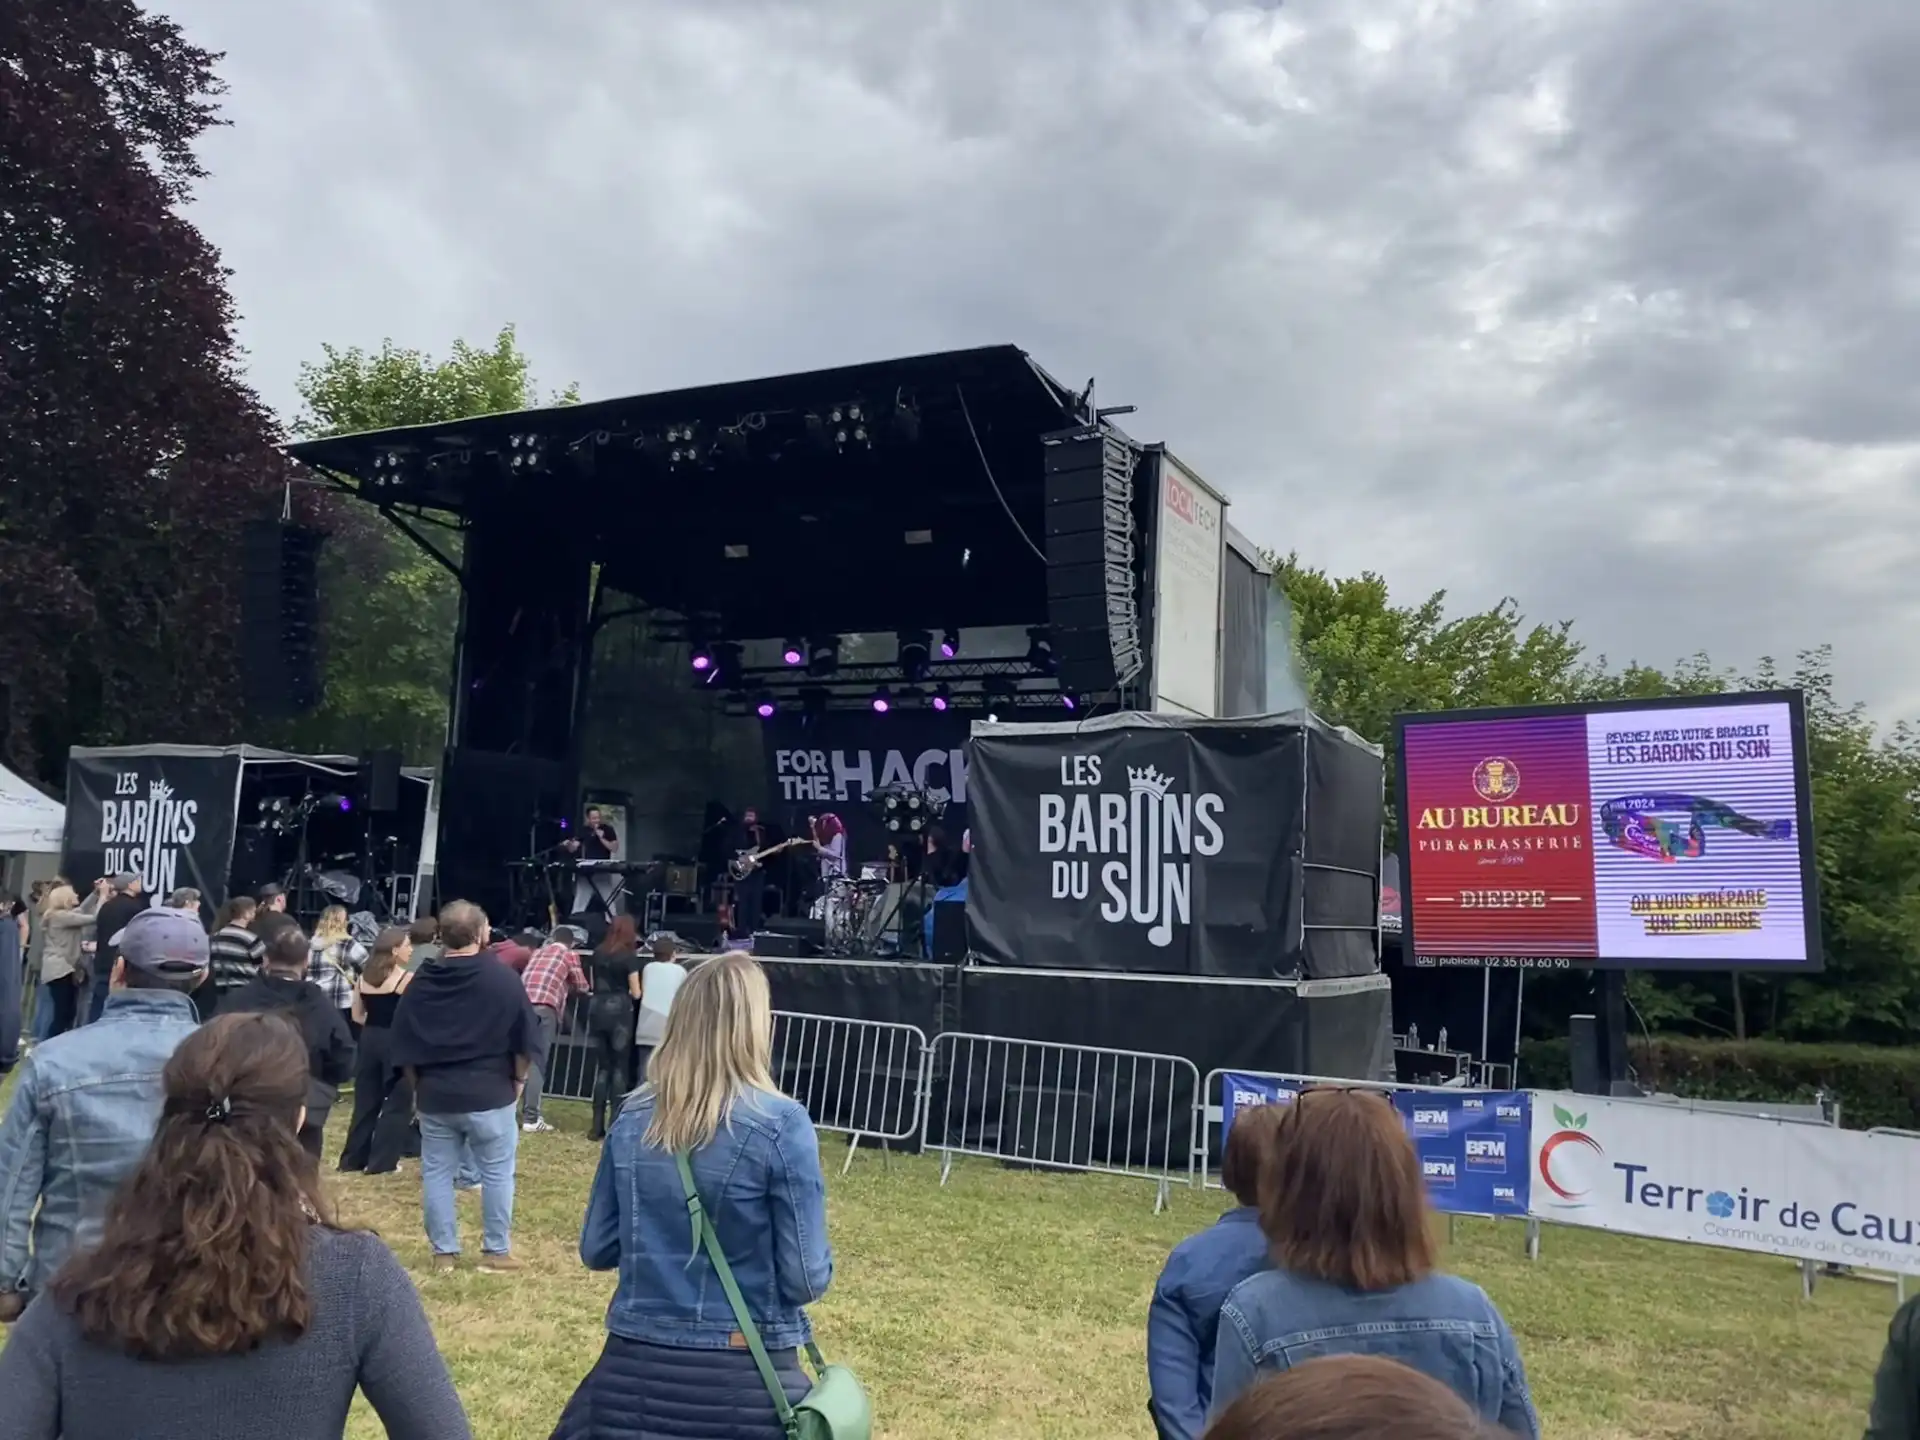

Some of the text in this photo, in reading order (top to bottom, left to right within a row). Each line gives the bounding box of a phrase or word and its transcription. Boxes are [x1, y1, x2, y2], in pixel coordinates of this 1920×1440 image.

[1606, 724, 1770, 744] REVENEZ AVEC VOTRE BRACELET
[776, 749, 829, 773] FOR
[1607, 739, 1771, 764] LES BARONS DU SON
[1061, 755, 1102, 787] LES
[115, 772, 139, 795] LES
[778, 775, 831, 800] THE
[1627, 798, 1656, 809] 2024
[101, 799, 198, 844] BARONS
[1039, 791, 1225, 856] BARONS
[1417, 804, 1581, 829] AU BUREAU
[104, 847, 178, 901] DU SON
[1052, 860, 1191, 946] DU SON
[1460, 890, 1547, 908] DIEPPE
[1631, 886, 1766, 911] ON VOUS PRÉPARE
[1651, 911, 1759, 931] UNE SURPRISE
[1485, 956, 1500, 967] 02
[1502, 957, 1518, 968] 35
[1519, 957, 1535, 968] 04
[1537, 957, 1553, 969] 60
[1554, 958, 1571, 969] 90
[1234, 1090, 1266, 1106] BFM
[1413, 1110, 1448, 1124] BFM
[1496, 1106, 1521, 1117] BFM
[1466, 1140, 1506, 1157] BFM
[1423, 1162, 1455, 1176] BFM
[1493, 1187, 1514, 1197] BFM
[1613, 1162, 1920, 1247] Terroir de Cau
[1703, 1221, 1810, 1250] Communauté
[1813, 1238, 1836, 1253] de
